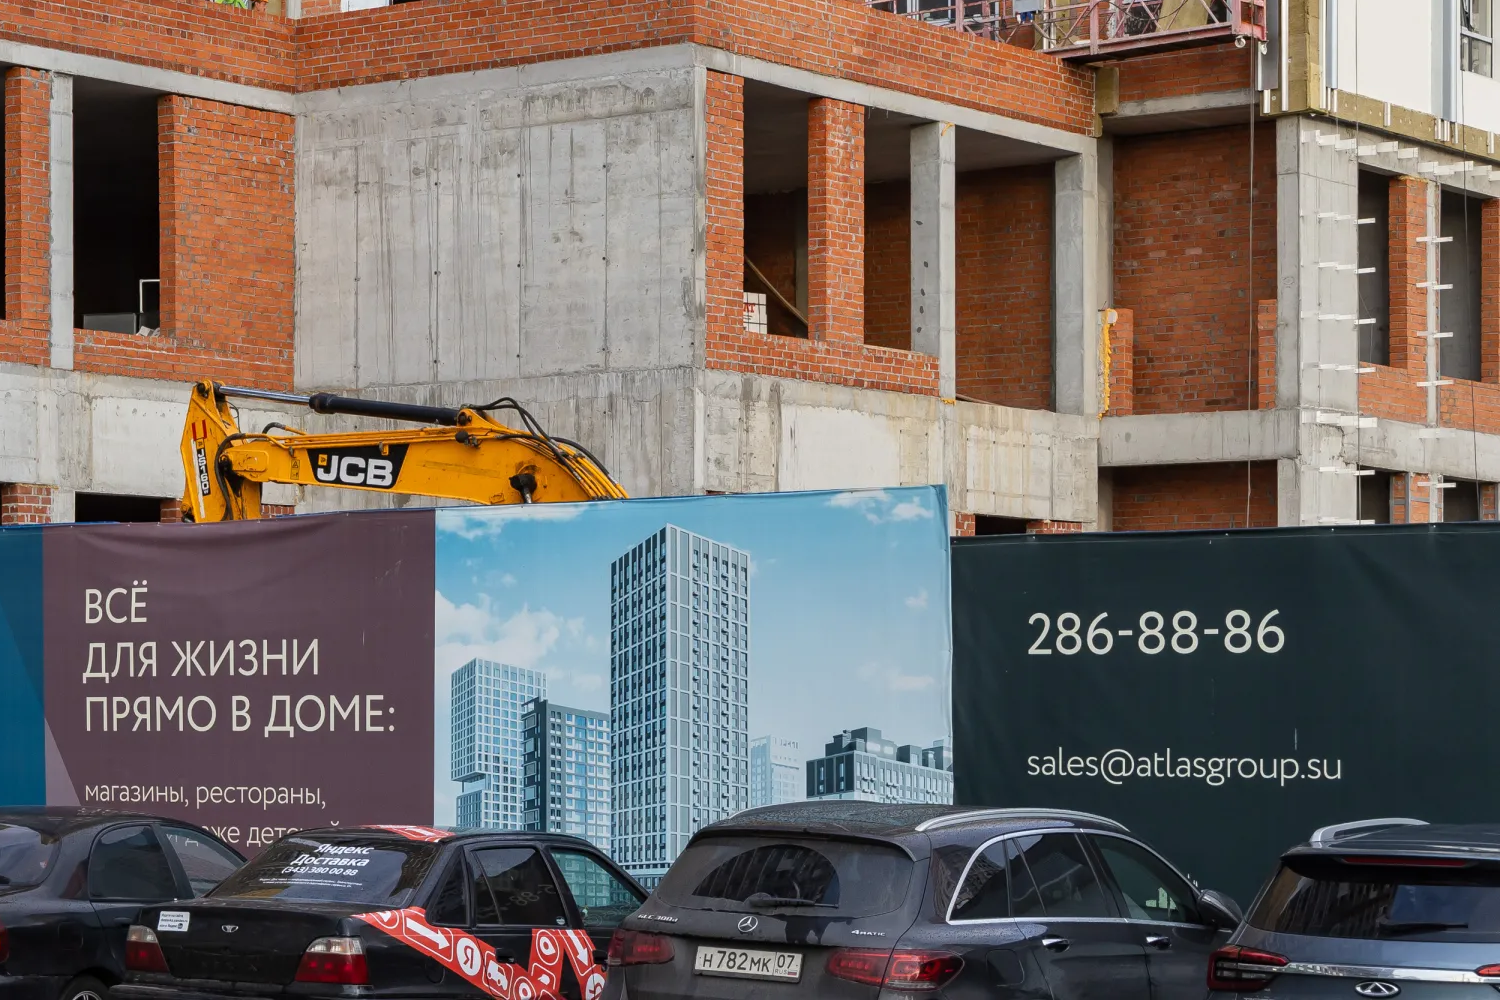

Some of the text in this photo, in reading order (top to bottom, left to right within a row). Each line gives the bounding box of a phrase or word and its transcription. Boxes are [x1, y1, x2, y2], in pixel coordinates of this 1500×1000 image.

[317, 455, 393, 486] JCB
[85, 579, 148, 624] ВСЁ
[1027, 608, 1285, 655] 286-88-86
[82, 638, 319, 684] ДЛЯ ЖИЗНИ
[86, 694, 395, 738] ПРЯМО В ДОМЕ:
[1027, 746, 1342, 787] sales@atlasgroup.su
[85, 785, 326, 810] магазины, рестораны,
[290, 854, 370, 867] Доставка
[314, 843, 375, 855] Яндекс
[281, 866, 358, 876] (343) 380 00 88
[777, 954, 795, 969] 07
